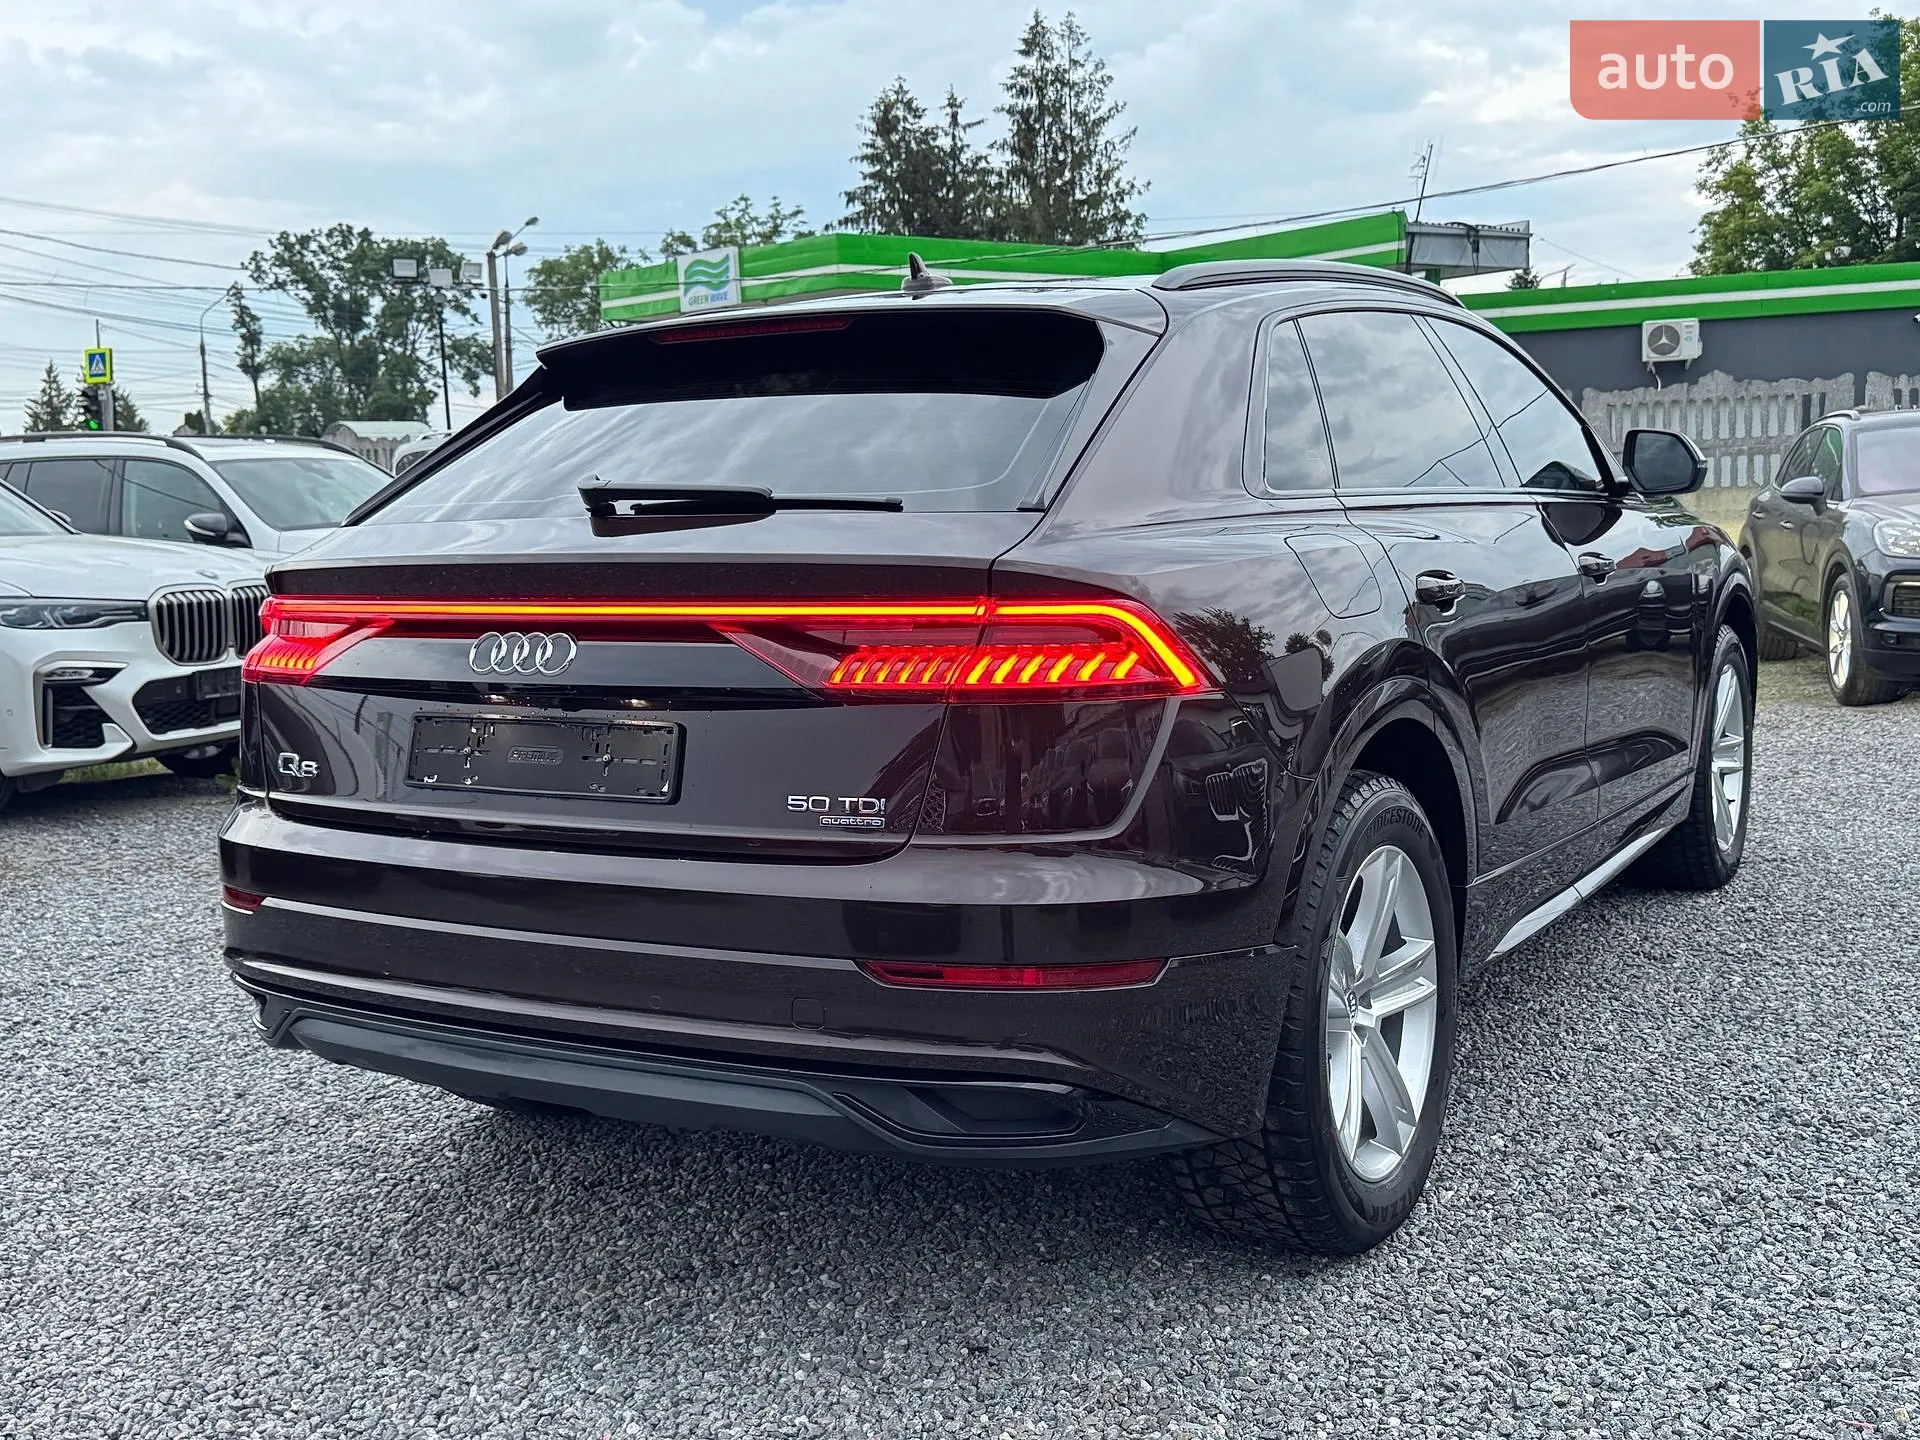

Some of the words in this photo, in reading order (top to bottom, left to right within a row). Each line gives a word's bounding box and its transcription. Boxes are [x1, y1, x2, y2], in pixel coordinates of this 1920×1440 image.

[688, 295, 709, 306] GREEN
[710, 291, 728, 303] WAVE
[279, 752, 318, 778] Q8
[787, 795, 830, 812] 50
[838, 797, 886, 814] TDI
[821, 817, 882, 827] quattro
